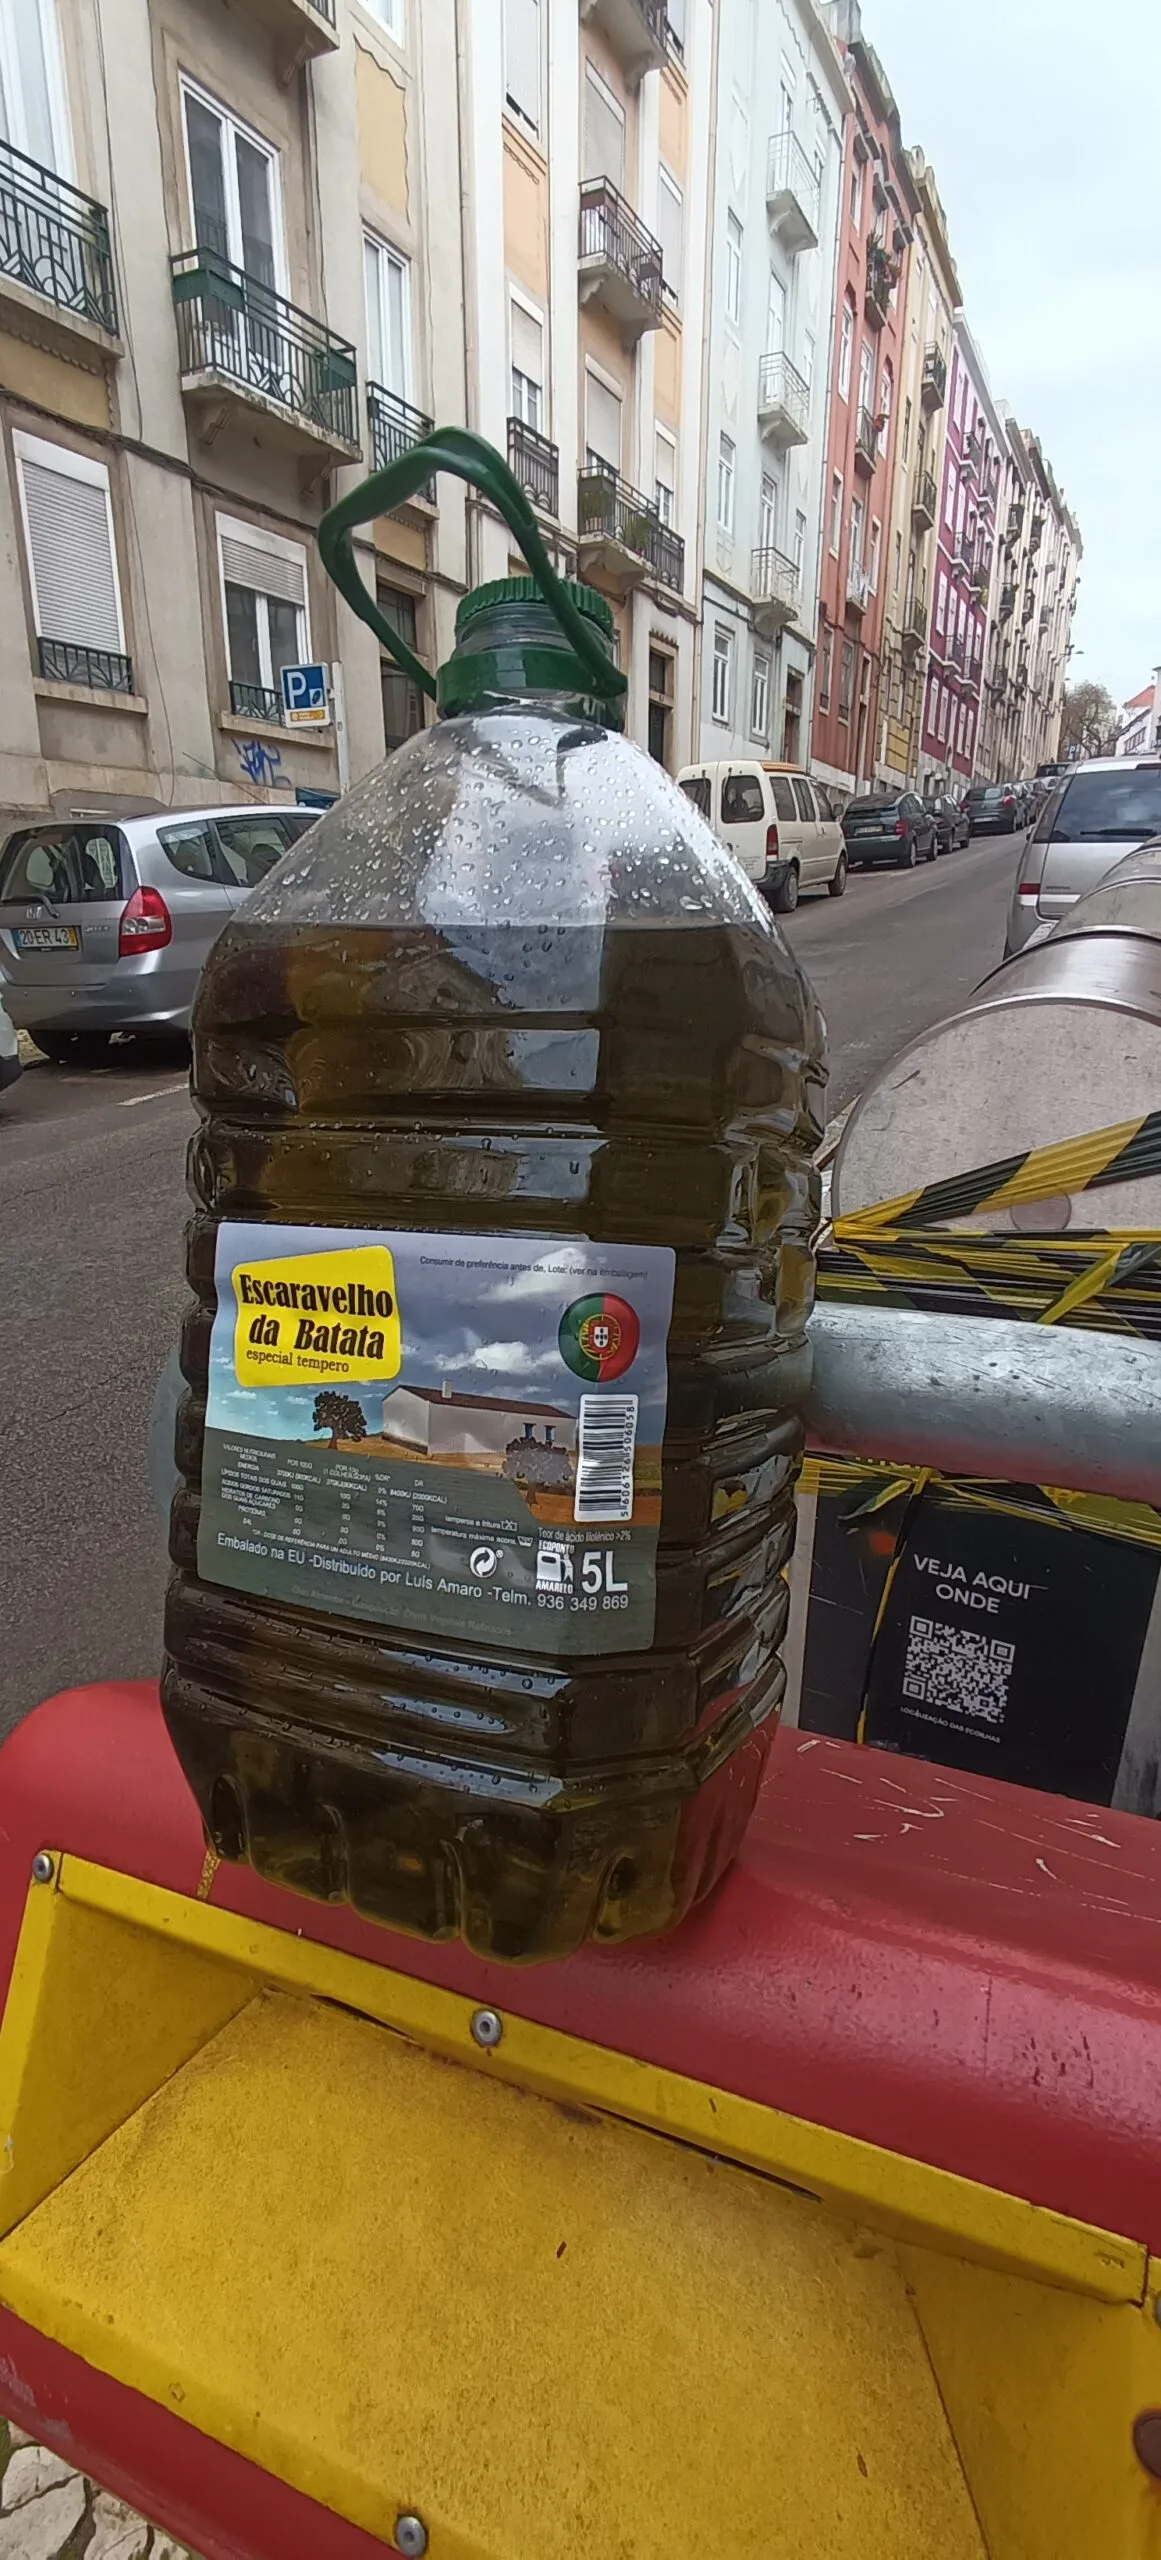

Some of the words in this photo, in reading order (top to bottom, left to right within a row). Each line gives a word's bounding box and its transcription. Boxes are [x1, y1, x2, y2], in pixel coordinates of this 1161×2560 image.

[287, 671, 307, 708] P
[420, 1256, 454, 1266] Consumir
[455, 1259, 465, 1267] de
[466, 1260, 509, 1270] preferência
[509, 1263, 532, 1271] antes
[547, 1265, 568, 1274] Lote:
[239, 1274, 393, 1318] Escaravelho
[249, 1314, 280, 1347] da
[294, 1318, 384, 1360] Batata
[246, 1349, 293, 1365] especial
[297, 1354, 350, 1373] tempero
[482, 1520, 500, 1529] fritura
[537, 1527, 553, 1539] Teor
[554, 1530, 564, 1540] de
[538, 1540, 575, 1555] ECOPONTO
[217, 1532, 268, 1556] Embalado
[271, 1548, 285, 1561] na
[288, 1549, 305, 1565] EU
[380, 1570, 401, 1585] por
[437, 1577, 482, 1598] Amaro
[537, 1594, 564, 1610] 936
[570, 1596, 597, 1612] 349
[602, 1594, 629, 1610] 869
[581, 1550, 629, 1594] 5L
[913, 1553, 967, 1583] VEJA
[972, 1571, 1030, 1600] AQUI
[535, 1580, 574, 1595] AMARELO
[935, 1583, 1001, 1614] ONDE
[949, 1722, 964, 1731] DAS
[965, 1727, 1000, 1743] ECOILHAS
